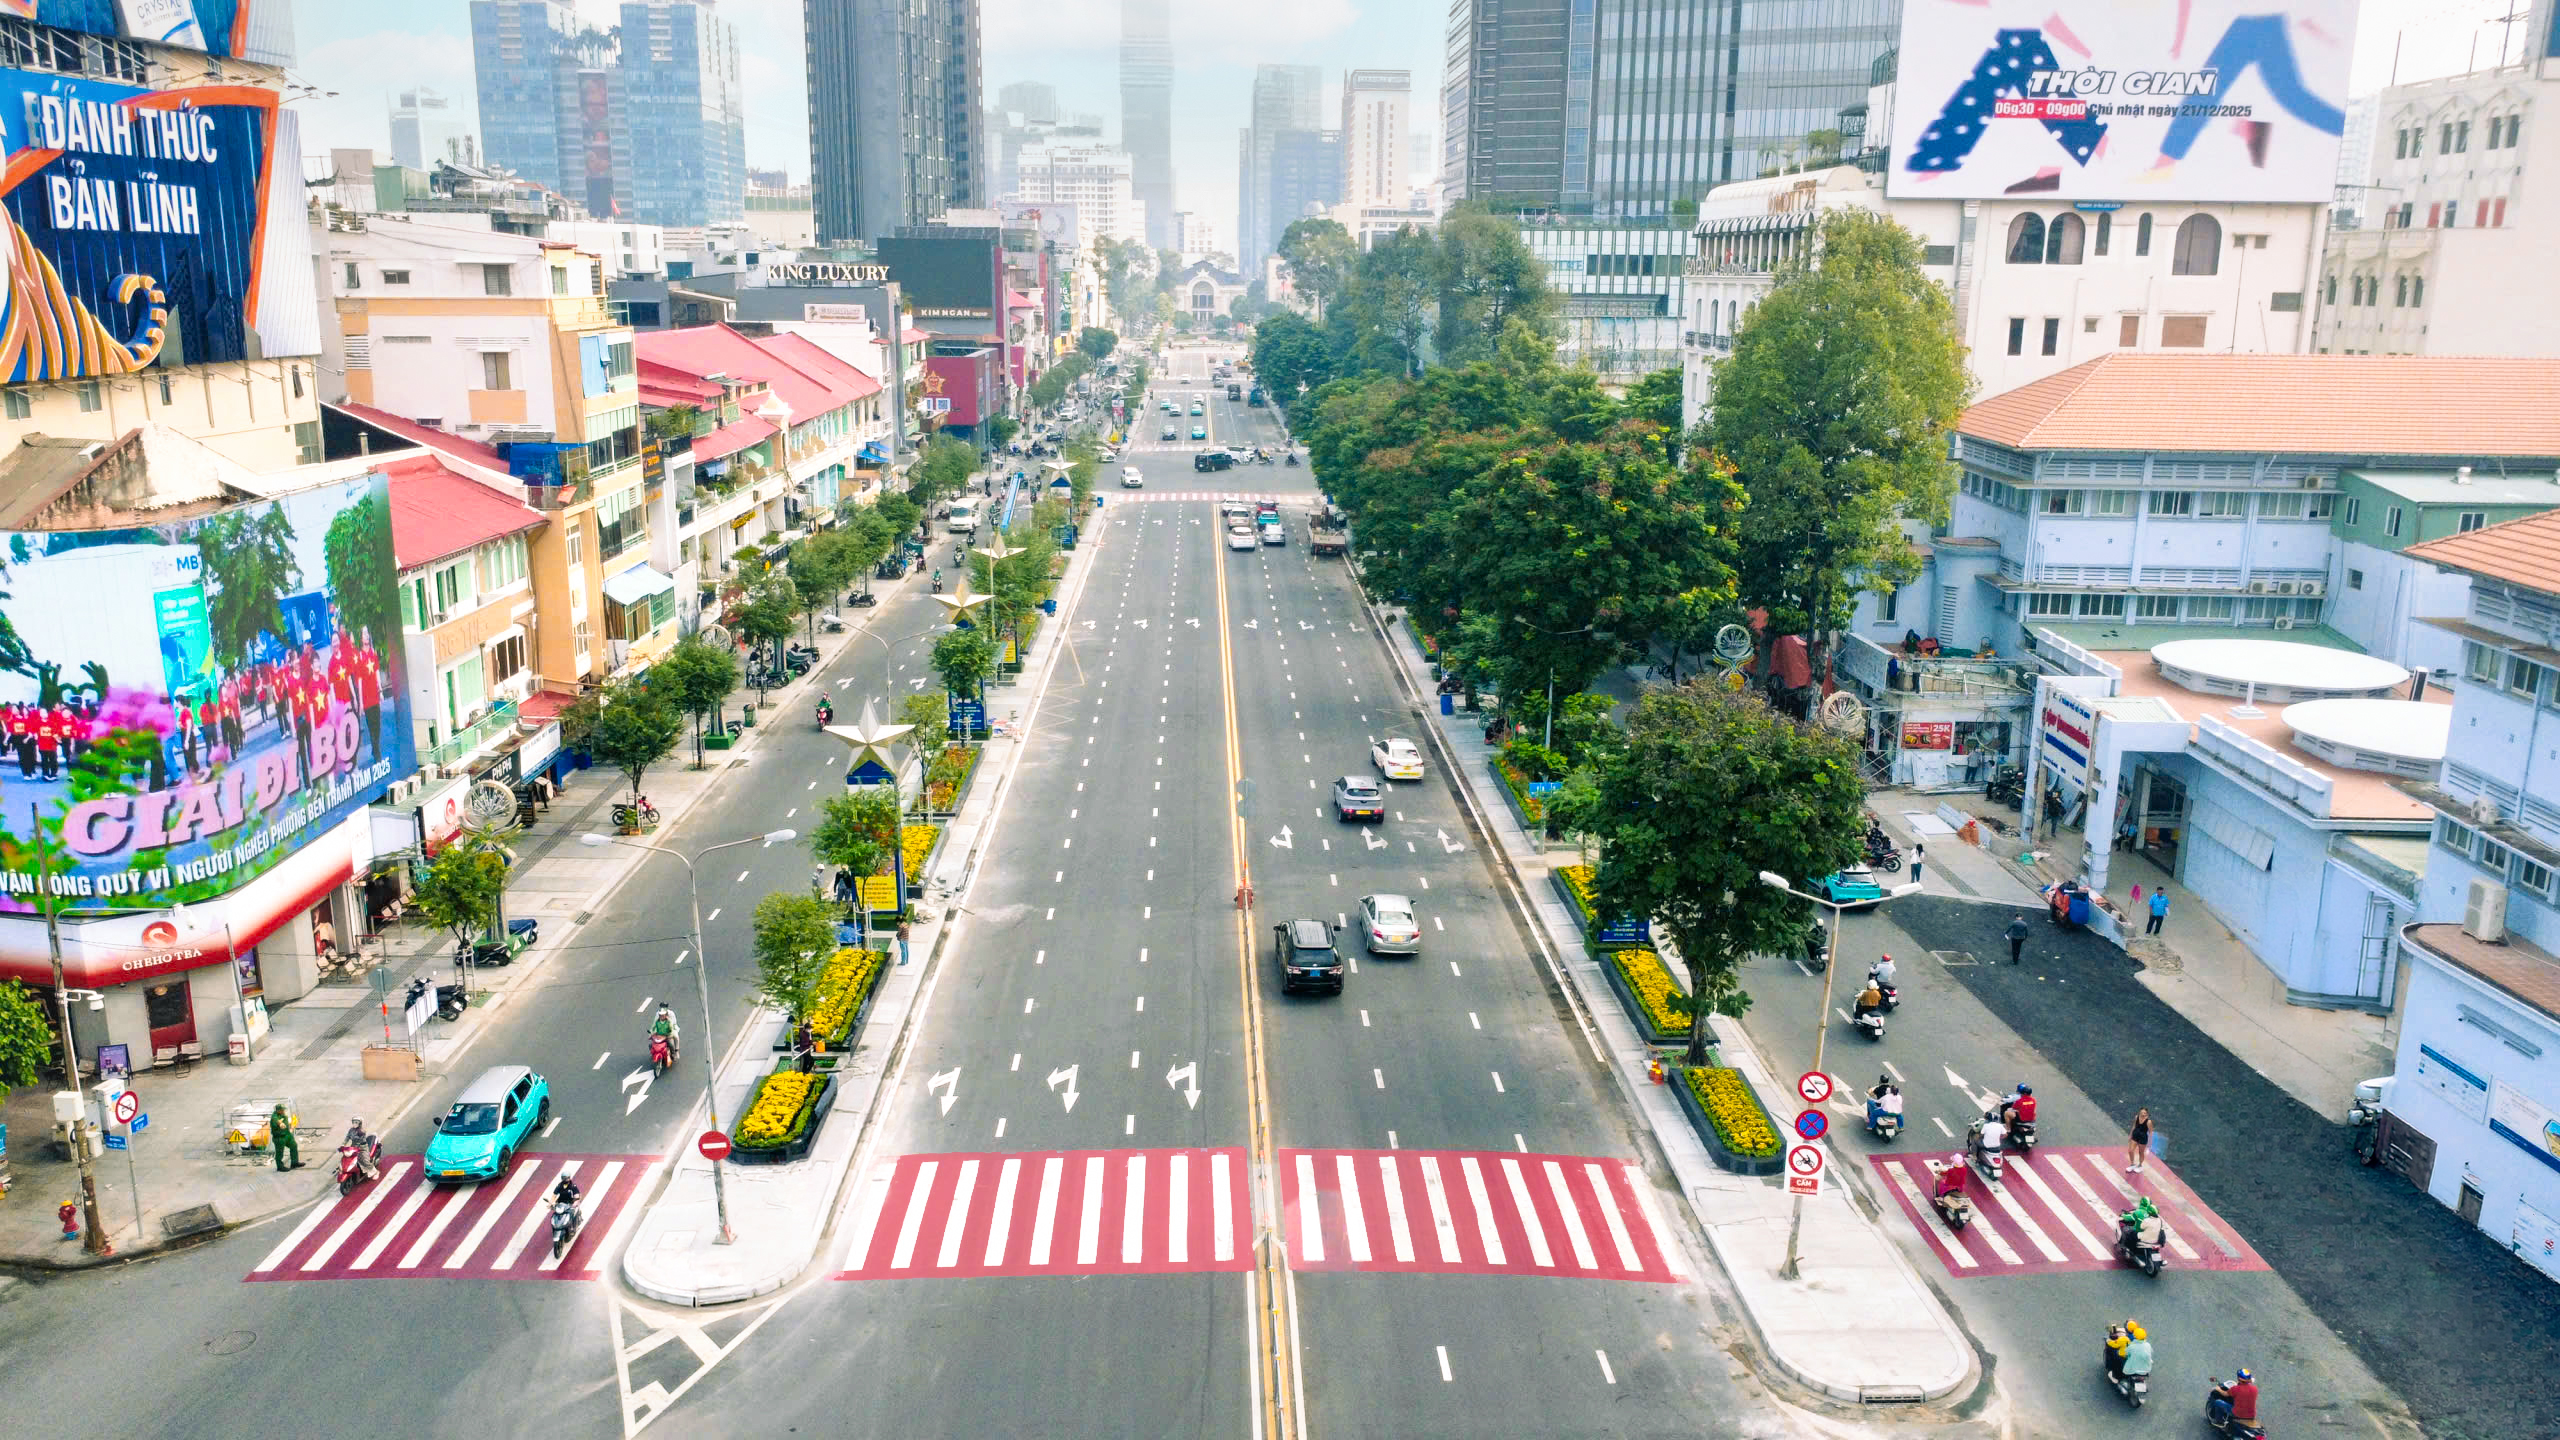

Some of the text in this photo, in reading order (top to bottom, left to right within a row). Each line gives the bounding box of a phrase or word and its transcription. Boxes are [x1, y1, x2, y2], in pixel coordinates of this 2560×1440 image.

[2030, 66, 2218, 97] THỜI GIAN
[1994, 102, 2034, 116] 06g30
[2046, 102, 2086, 117] 09g00
[2117, 103, 2145, 118] nhật
[2149, 104, 2178, 119] ngày
[2180, 103, 2252, 117] 21/12/2025
[41, 82, 218, 164] ĐÁNH THỨC
[48, 159, 200, 235] BẢN LĨNH
[767, 264, 890, 281] KING LUXURY
[921, 309, 940, 317] KIM
[942, 309, 971, 317] NGAN
[177, 555, 199, 571] MB
[256, 739, 300, 811] ĐI
[311, 705, 360, 781] BỘ
[0, 868, 34, 896] VẬN
[97, 868, 141, 897] QUỸ
[148, 864, 171, 890] VÌ
[176, 849, 233, 884] NGƯỜI
[271, 806, 306, 845] PHƯỜNG
[372, 757, 391, 782] 2025
[174, 948, 203, 961] TEA
